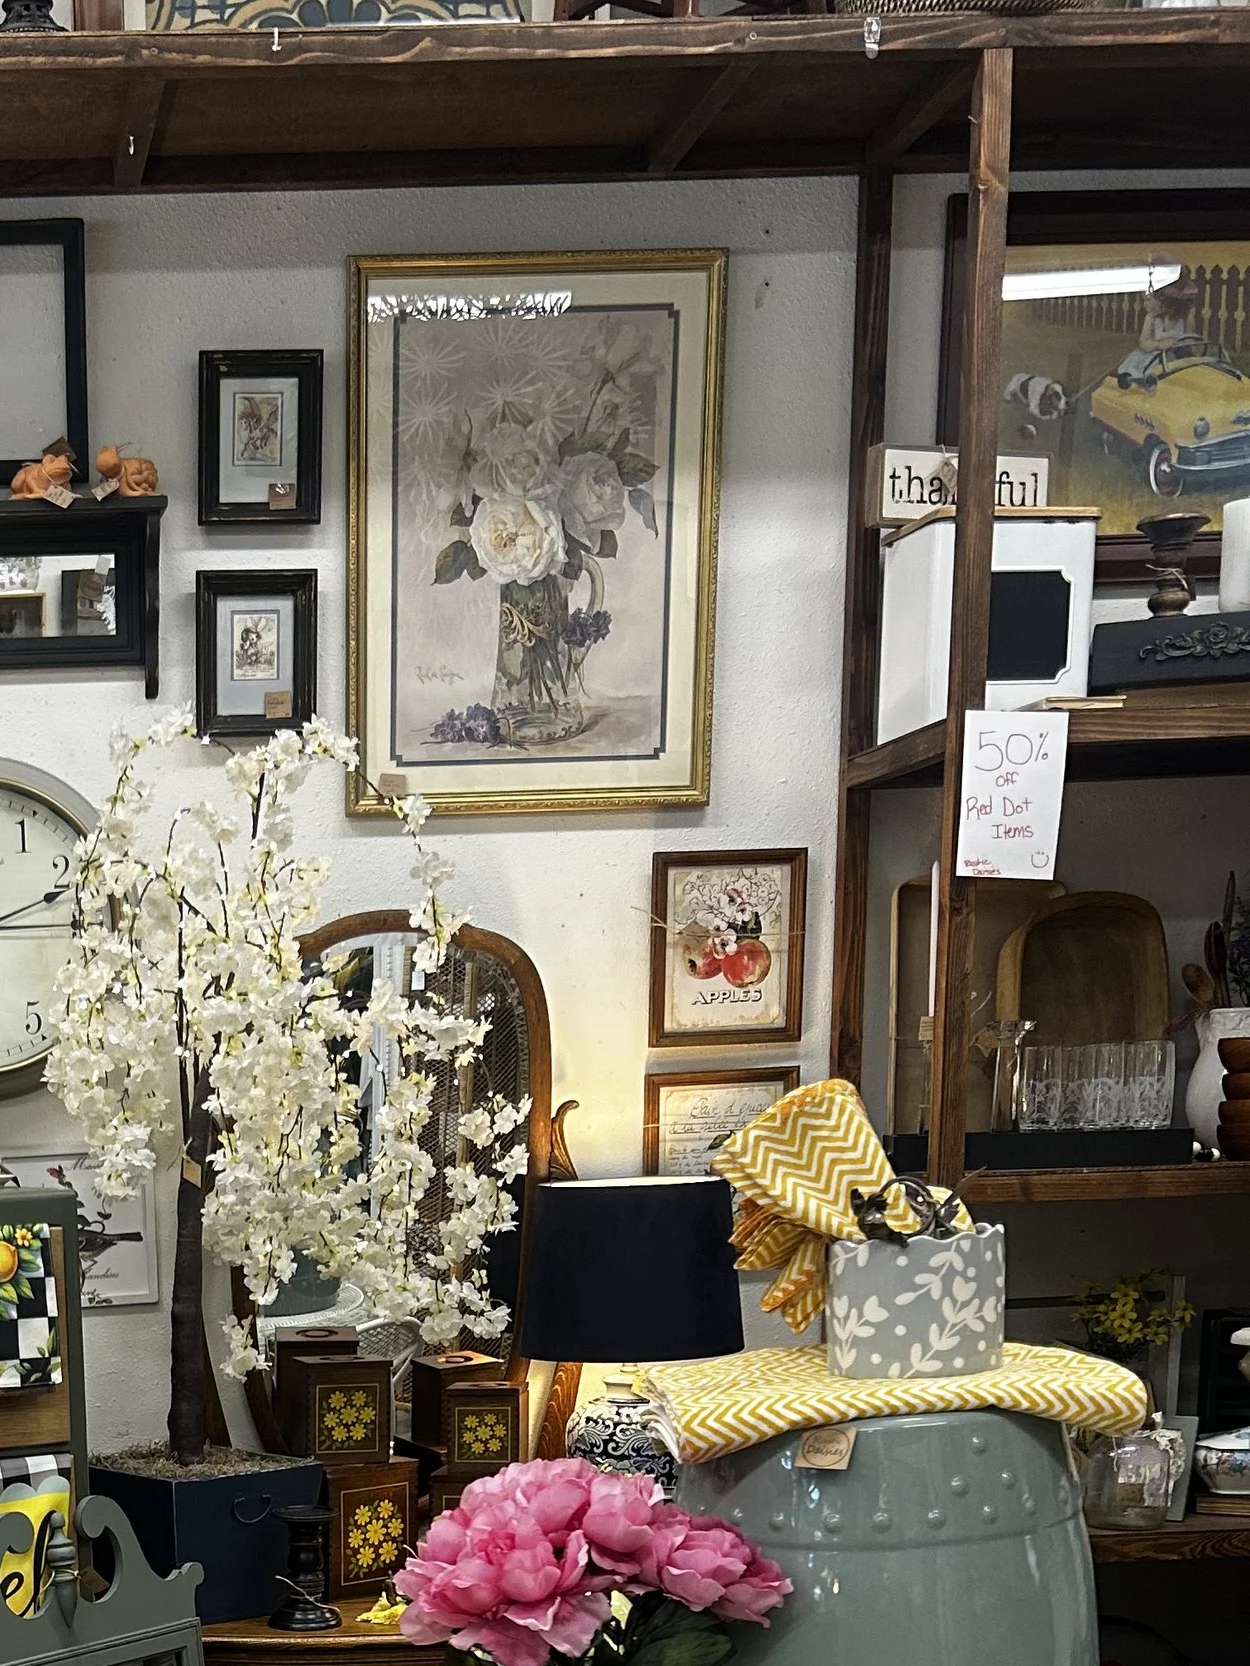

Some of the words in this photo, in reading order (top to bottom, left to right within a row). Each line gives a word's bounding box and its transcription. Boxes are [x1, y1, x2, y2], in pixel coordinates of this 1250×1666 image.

[888, 466, 1040, 507] thaful
[974, 730, 1050, 772] 50%
[966, 795, 993, 821] Red
[1002, 796, 1034, 817] Dot
[14, 819, 32, 855] 1
[991, 823, 1035, 840] Items
[51, 855, 73, 890] 2
[690, 988, 764, 1006] APPLES
[25, 1000, 43, 1035] 5
